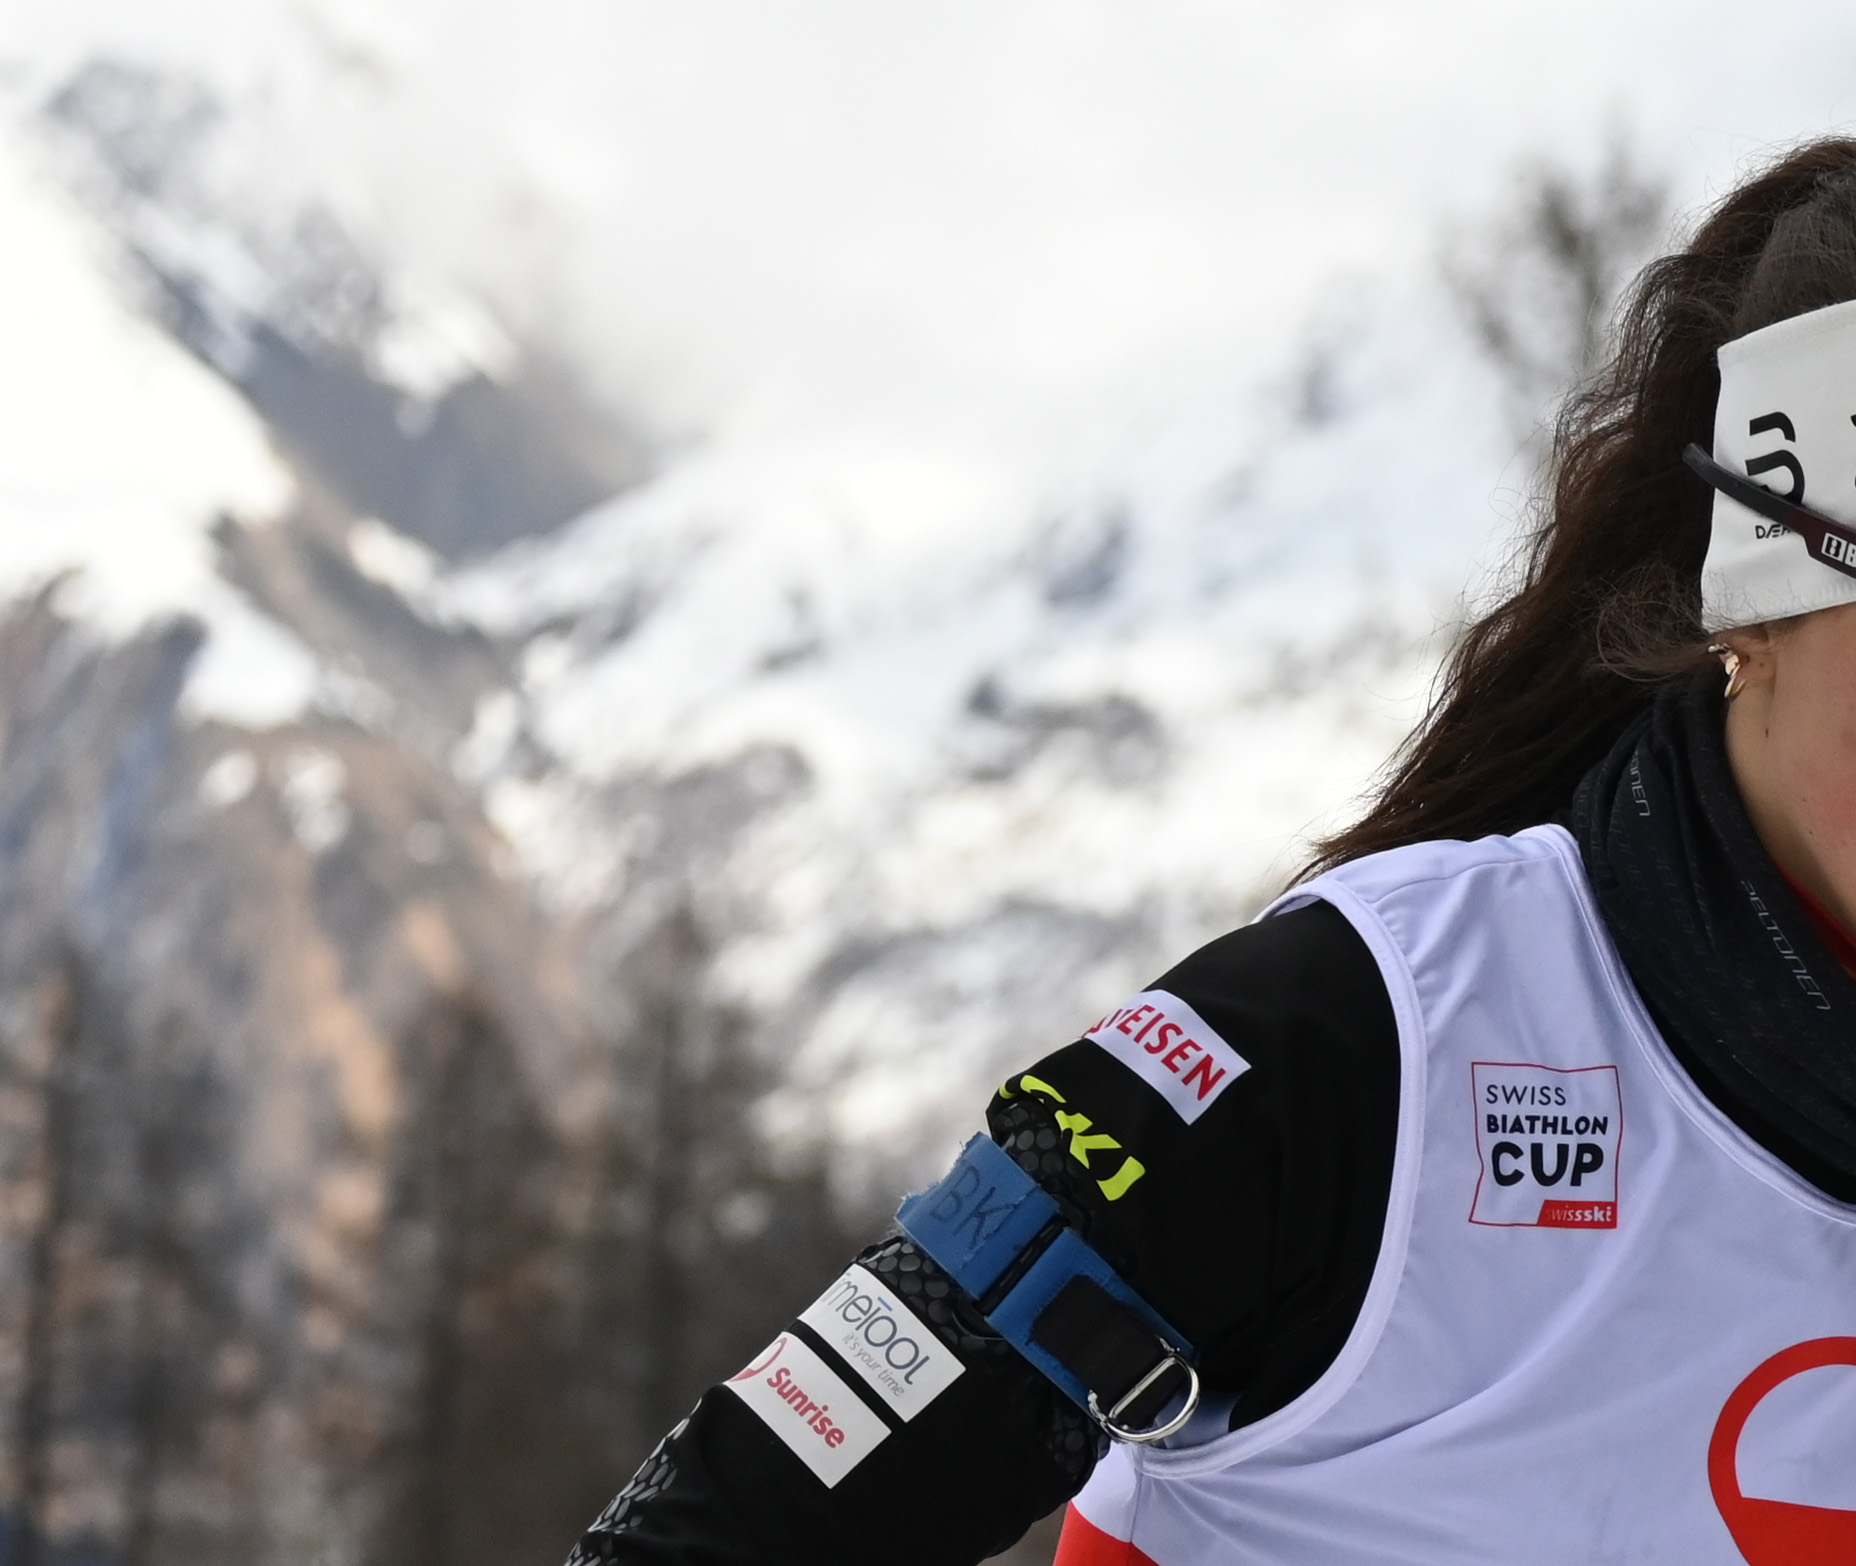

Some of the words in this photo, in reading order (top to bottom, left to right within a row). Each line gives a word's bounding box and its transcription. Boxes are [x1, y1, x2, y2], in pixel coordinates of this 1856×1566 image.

[1092, 1004, 1227, 1102] EISEN
[1486, 1084, 1567, 1106] SWISS
[1486, 1114, 1609, 1136] BIATHLON
[1491, 1141, 1604, 1187] CUP
[854, 1347, 882, 1370] your
[878, 1368, 905, 1397] time
[766, 1367, 845, 1449] Sunrise
